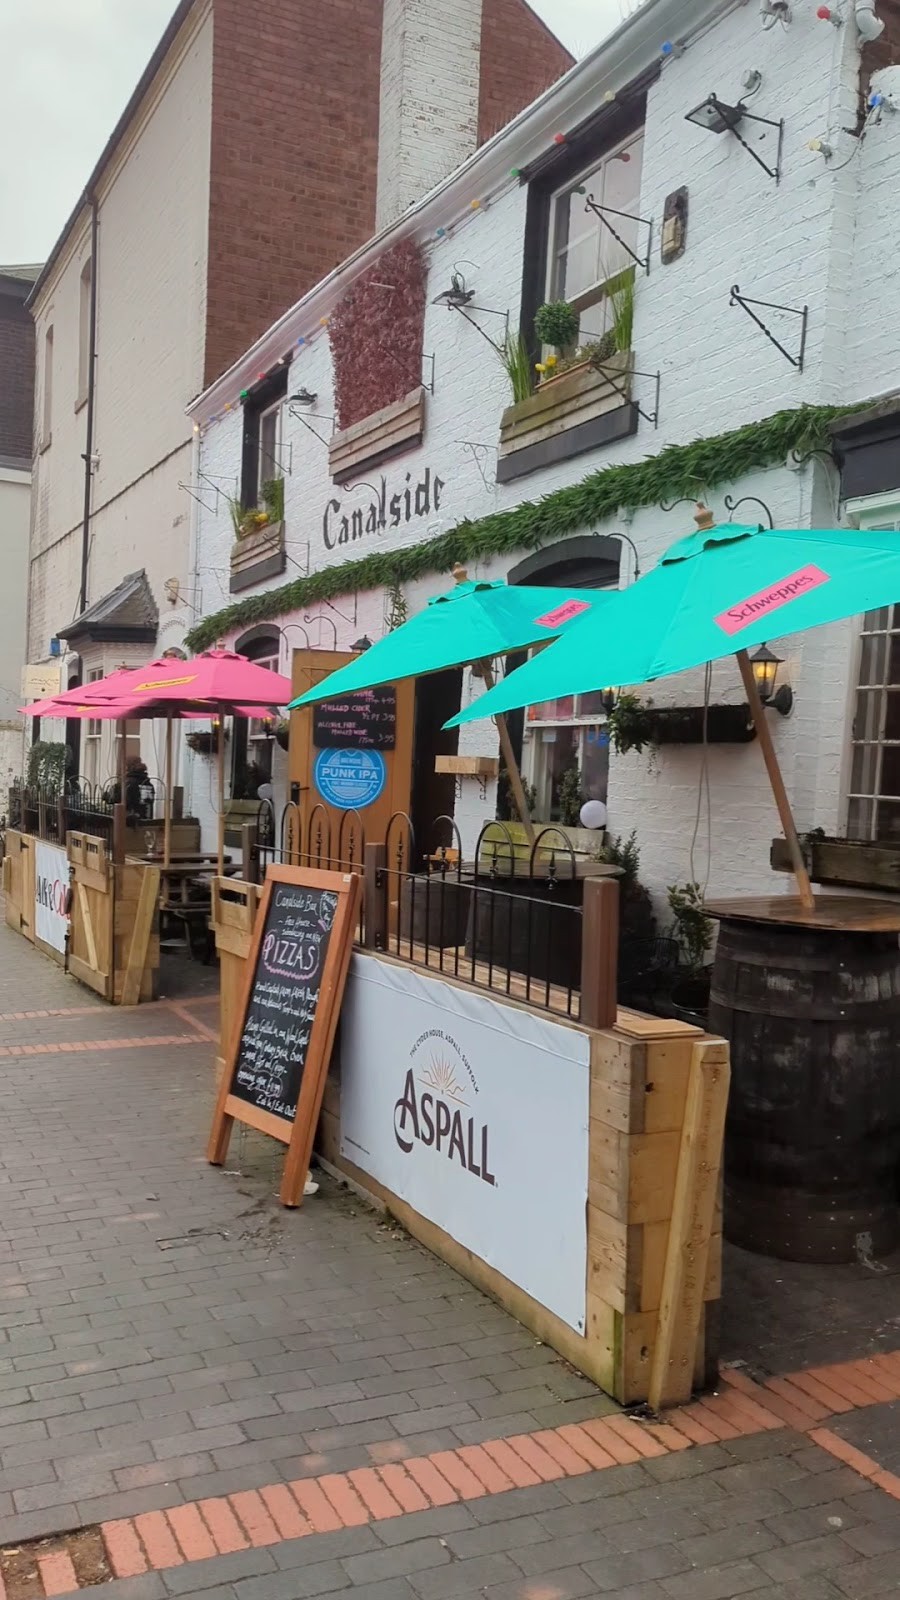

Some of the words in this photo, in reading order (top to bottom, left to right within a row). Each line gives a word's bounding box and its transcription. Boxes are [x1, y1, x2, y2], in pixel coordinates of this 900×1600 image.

[323, 467, 445, 550] Canalside
[727, 575, 814, 622] Schweppes
[322, 767, 356, 779] PUNK
[358, 770, 378, 780] IPA
[303, 894, 318, 915] Bar
[264, 934, 316, 970] PIZZAS
[462, 1054, 479, 1094] SUFFOLK
[394, 1068, 495, 1187] ASPALL
